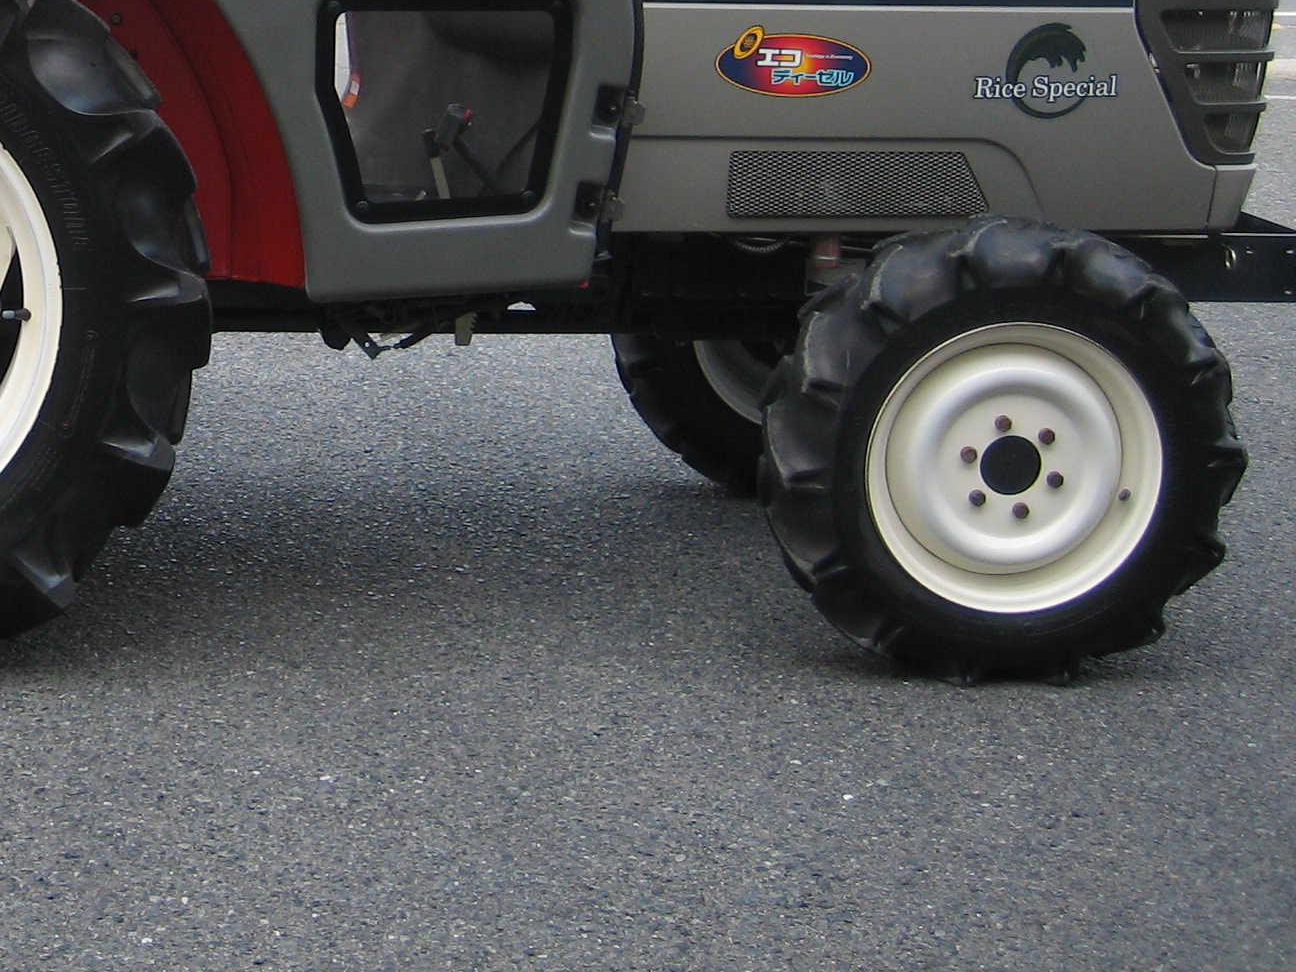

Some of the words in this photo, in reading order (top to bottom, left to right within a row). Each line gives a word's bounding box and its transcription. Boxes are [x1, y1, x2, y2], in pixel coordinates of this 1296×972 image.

[757, 48, 802, 67] エコ
[771, 68, 854, 87] ディーゼル
[974, 76, 1027, 99] Rice
[1031, 74, 1118, 103] Special
